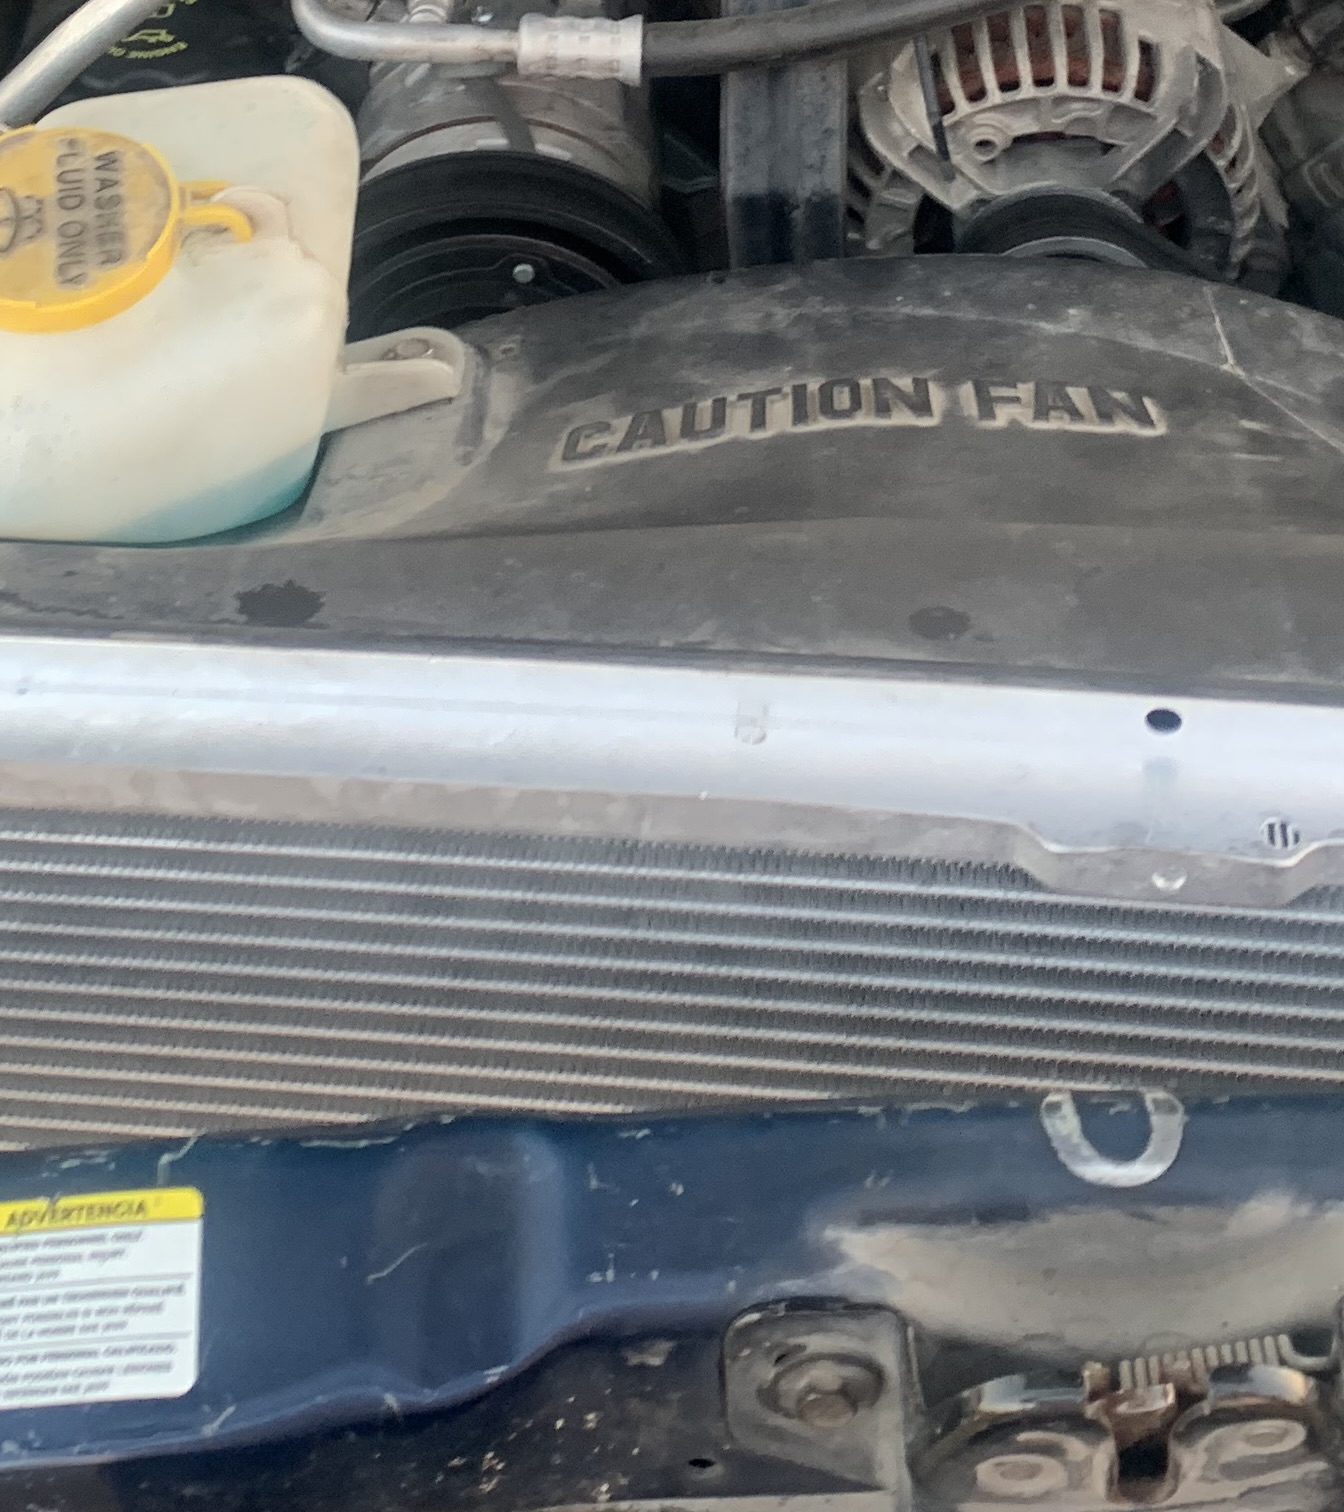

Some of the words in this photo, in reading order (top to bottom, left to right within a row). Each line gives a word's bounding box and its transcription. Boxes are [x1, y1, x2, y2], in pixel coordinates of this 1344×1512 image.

[94, 150, 126, 268] WASHER
[56, 221, 88, 286] ONLY
[560, 376, 938, 464] CAUTION
[969, 378, 1163, 430] FAN
